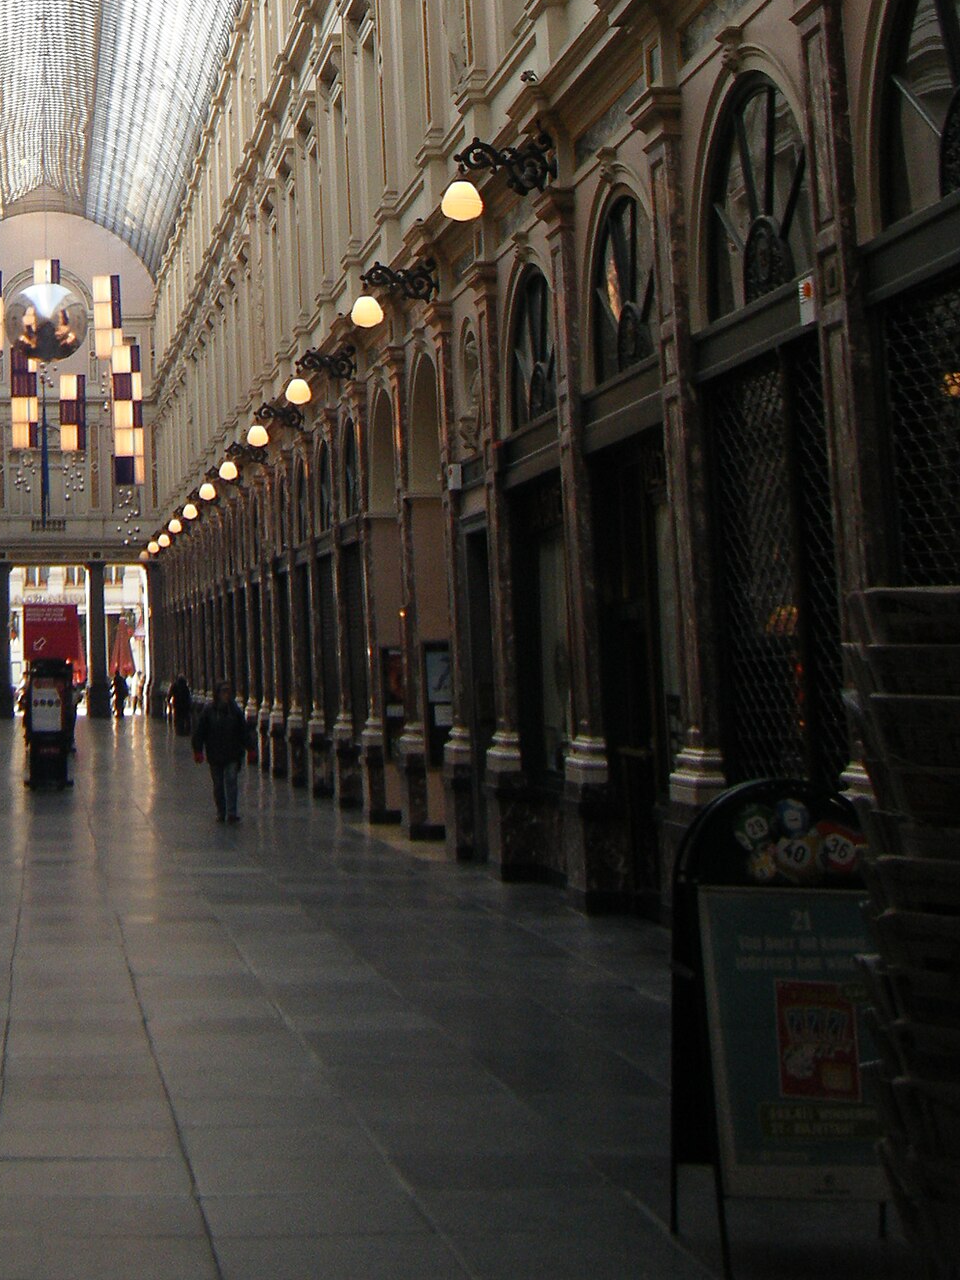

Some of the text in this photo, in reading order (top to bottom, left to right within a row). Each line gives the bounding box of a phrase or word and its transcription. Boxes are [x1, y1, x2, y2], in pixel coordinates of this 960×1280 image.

[748, 819, 765, 837] 29
[783, 844, 806, 863] 40
[828, 838, 850, 860] 36
